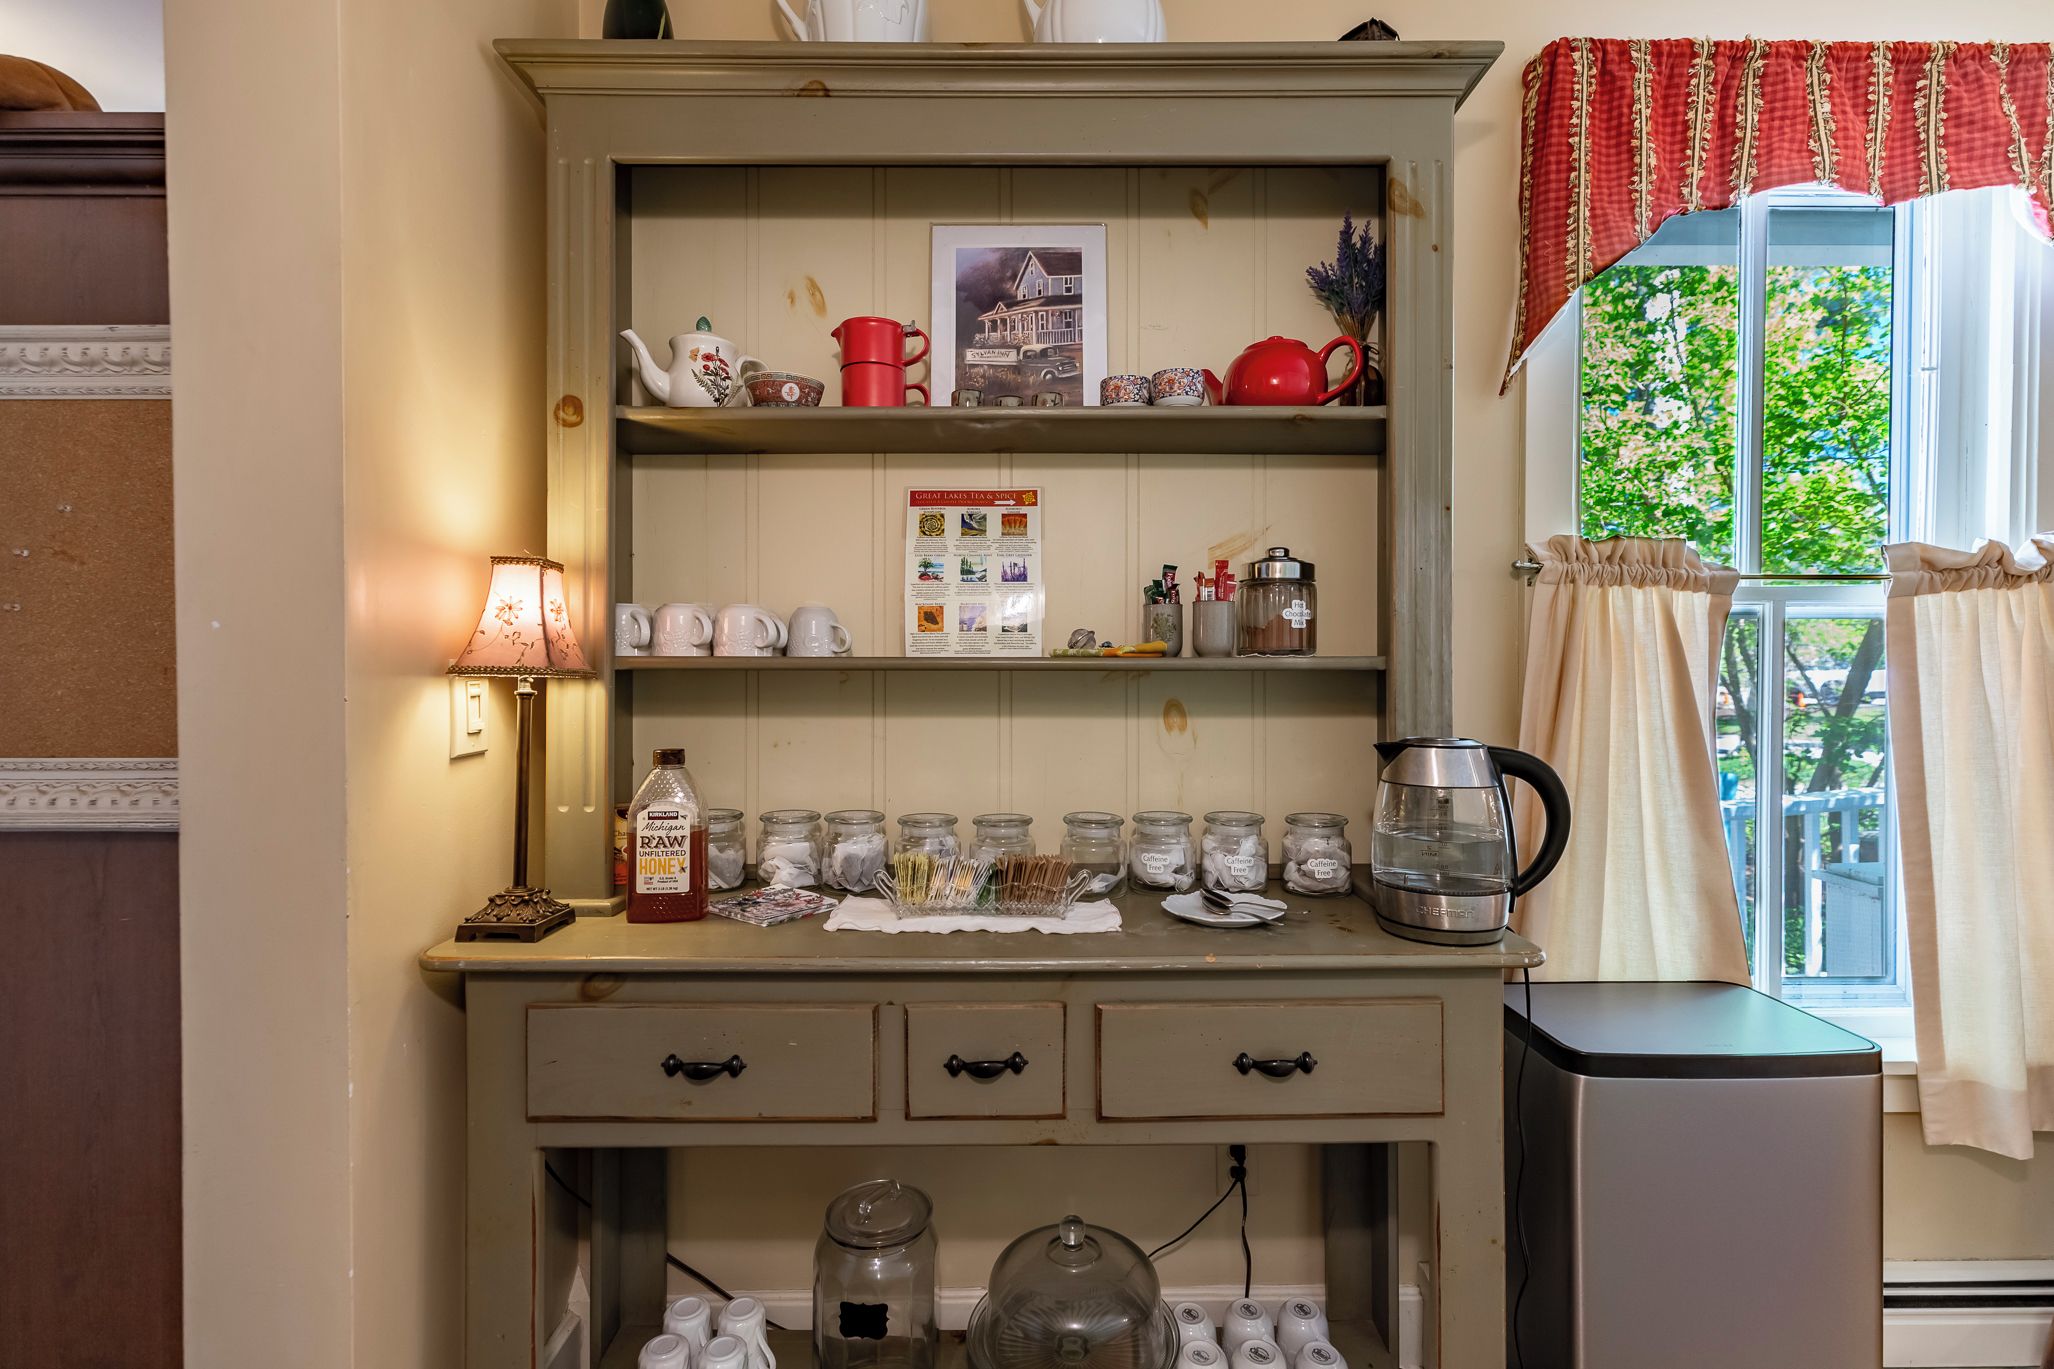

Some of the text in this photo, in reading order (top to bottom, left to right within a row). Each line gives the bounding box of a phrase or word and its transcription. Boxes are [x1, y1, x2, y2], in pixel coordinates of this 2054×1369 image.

[971, 350, 996, 358] SYLVAN
[997, 350, 1010, 358] INN
[915, 491, 1016, 500] GREAT LAKES TEA & SPICE
[1294, 601, 1304, 609] Hot
[641, 821, 686, 836] Michigan
[640, 835, 688, 849] RAW
[1142, 854, 1168, 863] Caffeine
[1227, 857, 1253, 865] Caffeine
[640, 858, 687, 875] HONEY
[1310, 860, 1337, 868] Caffeine
